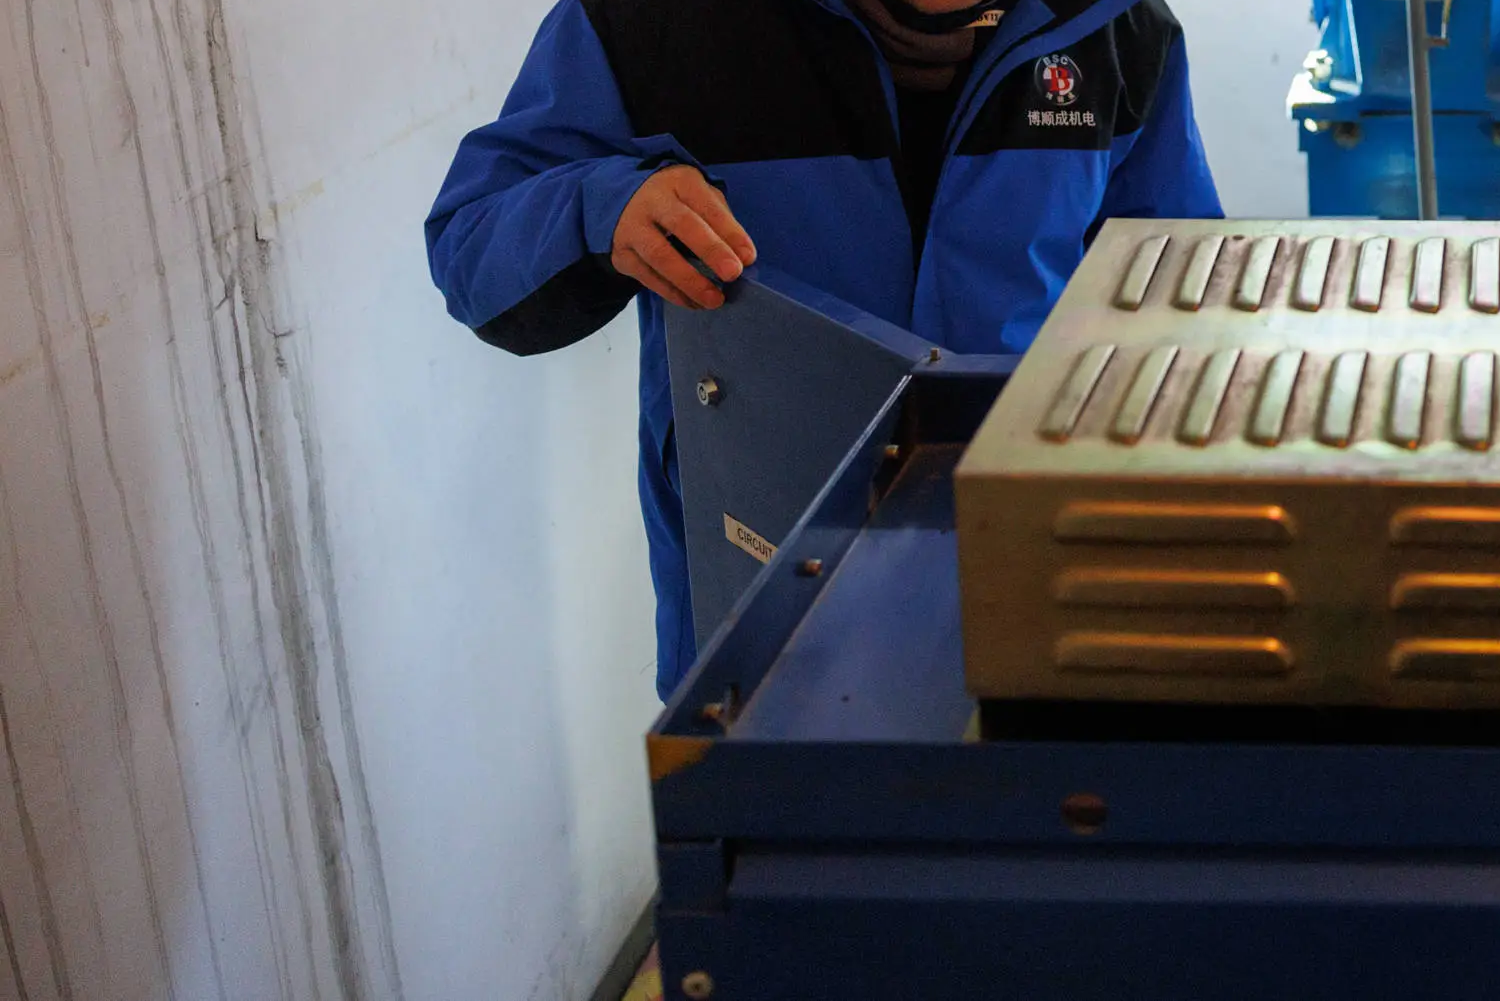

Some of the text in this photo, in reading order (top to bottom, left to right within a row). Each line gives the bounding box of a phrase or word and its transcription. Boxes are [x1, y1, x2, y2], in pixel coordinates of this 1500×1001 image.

[1042, 54, 1069, 66] BSC
[1027, 110, 1096, 127] 博顺成机电
[737, 527, 773, 560] CIRCUIT
